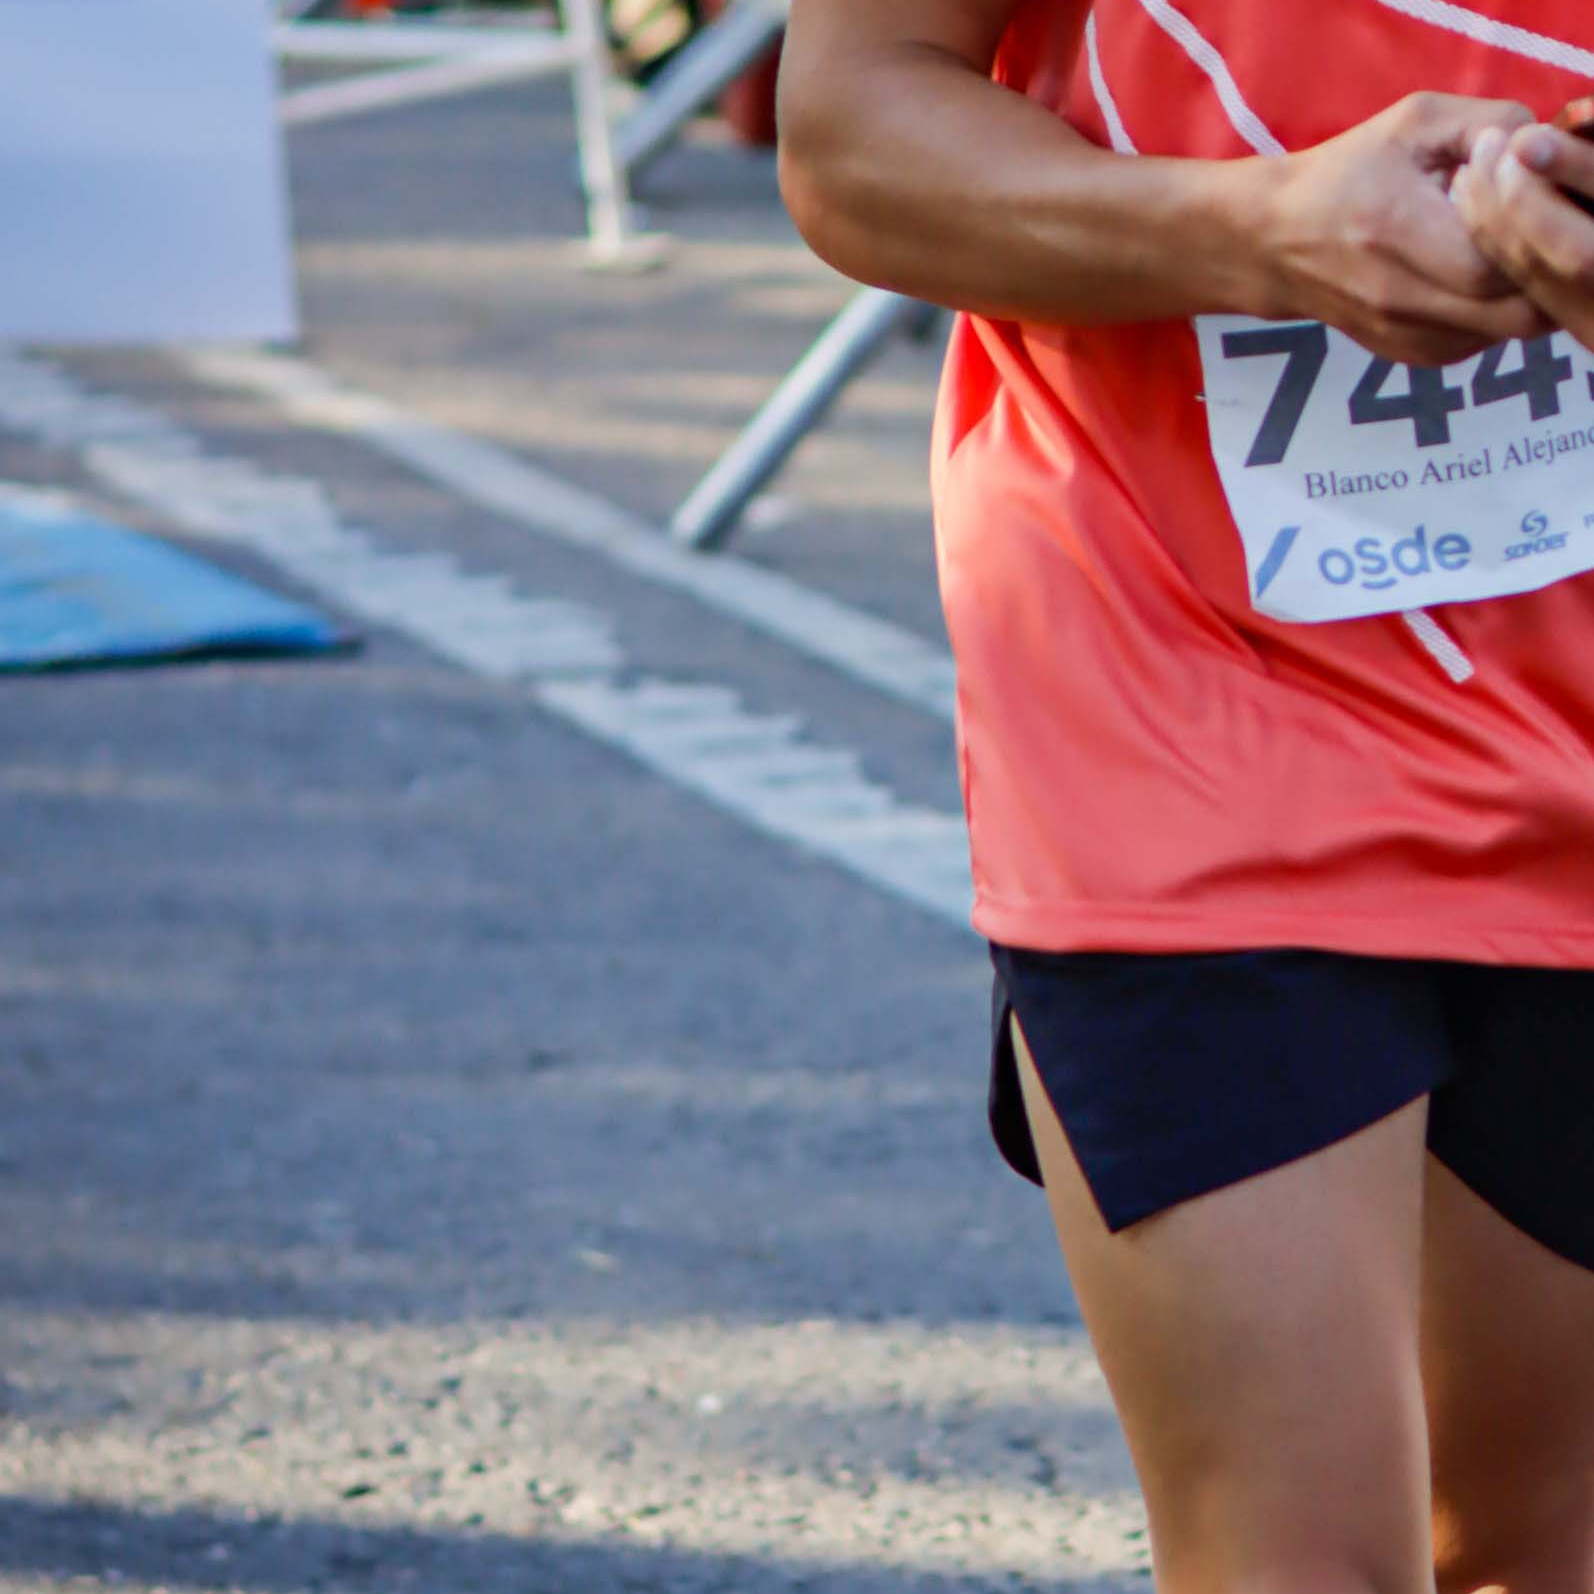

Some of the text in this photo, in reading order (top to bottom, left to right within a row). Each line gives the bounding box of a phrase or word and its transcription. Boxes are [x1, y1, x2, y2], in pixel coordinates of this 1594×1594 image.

[1304, 468, 1409, 499] Blanco
[1420, 449, 1492, 486] Ariel
[1318, 524, 1473, 589] osde
